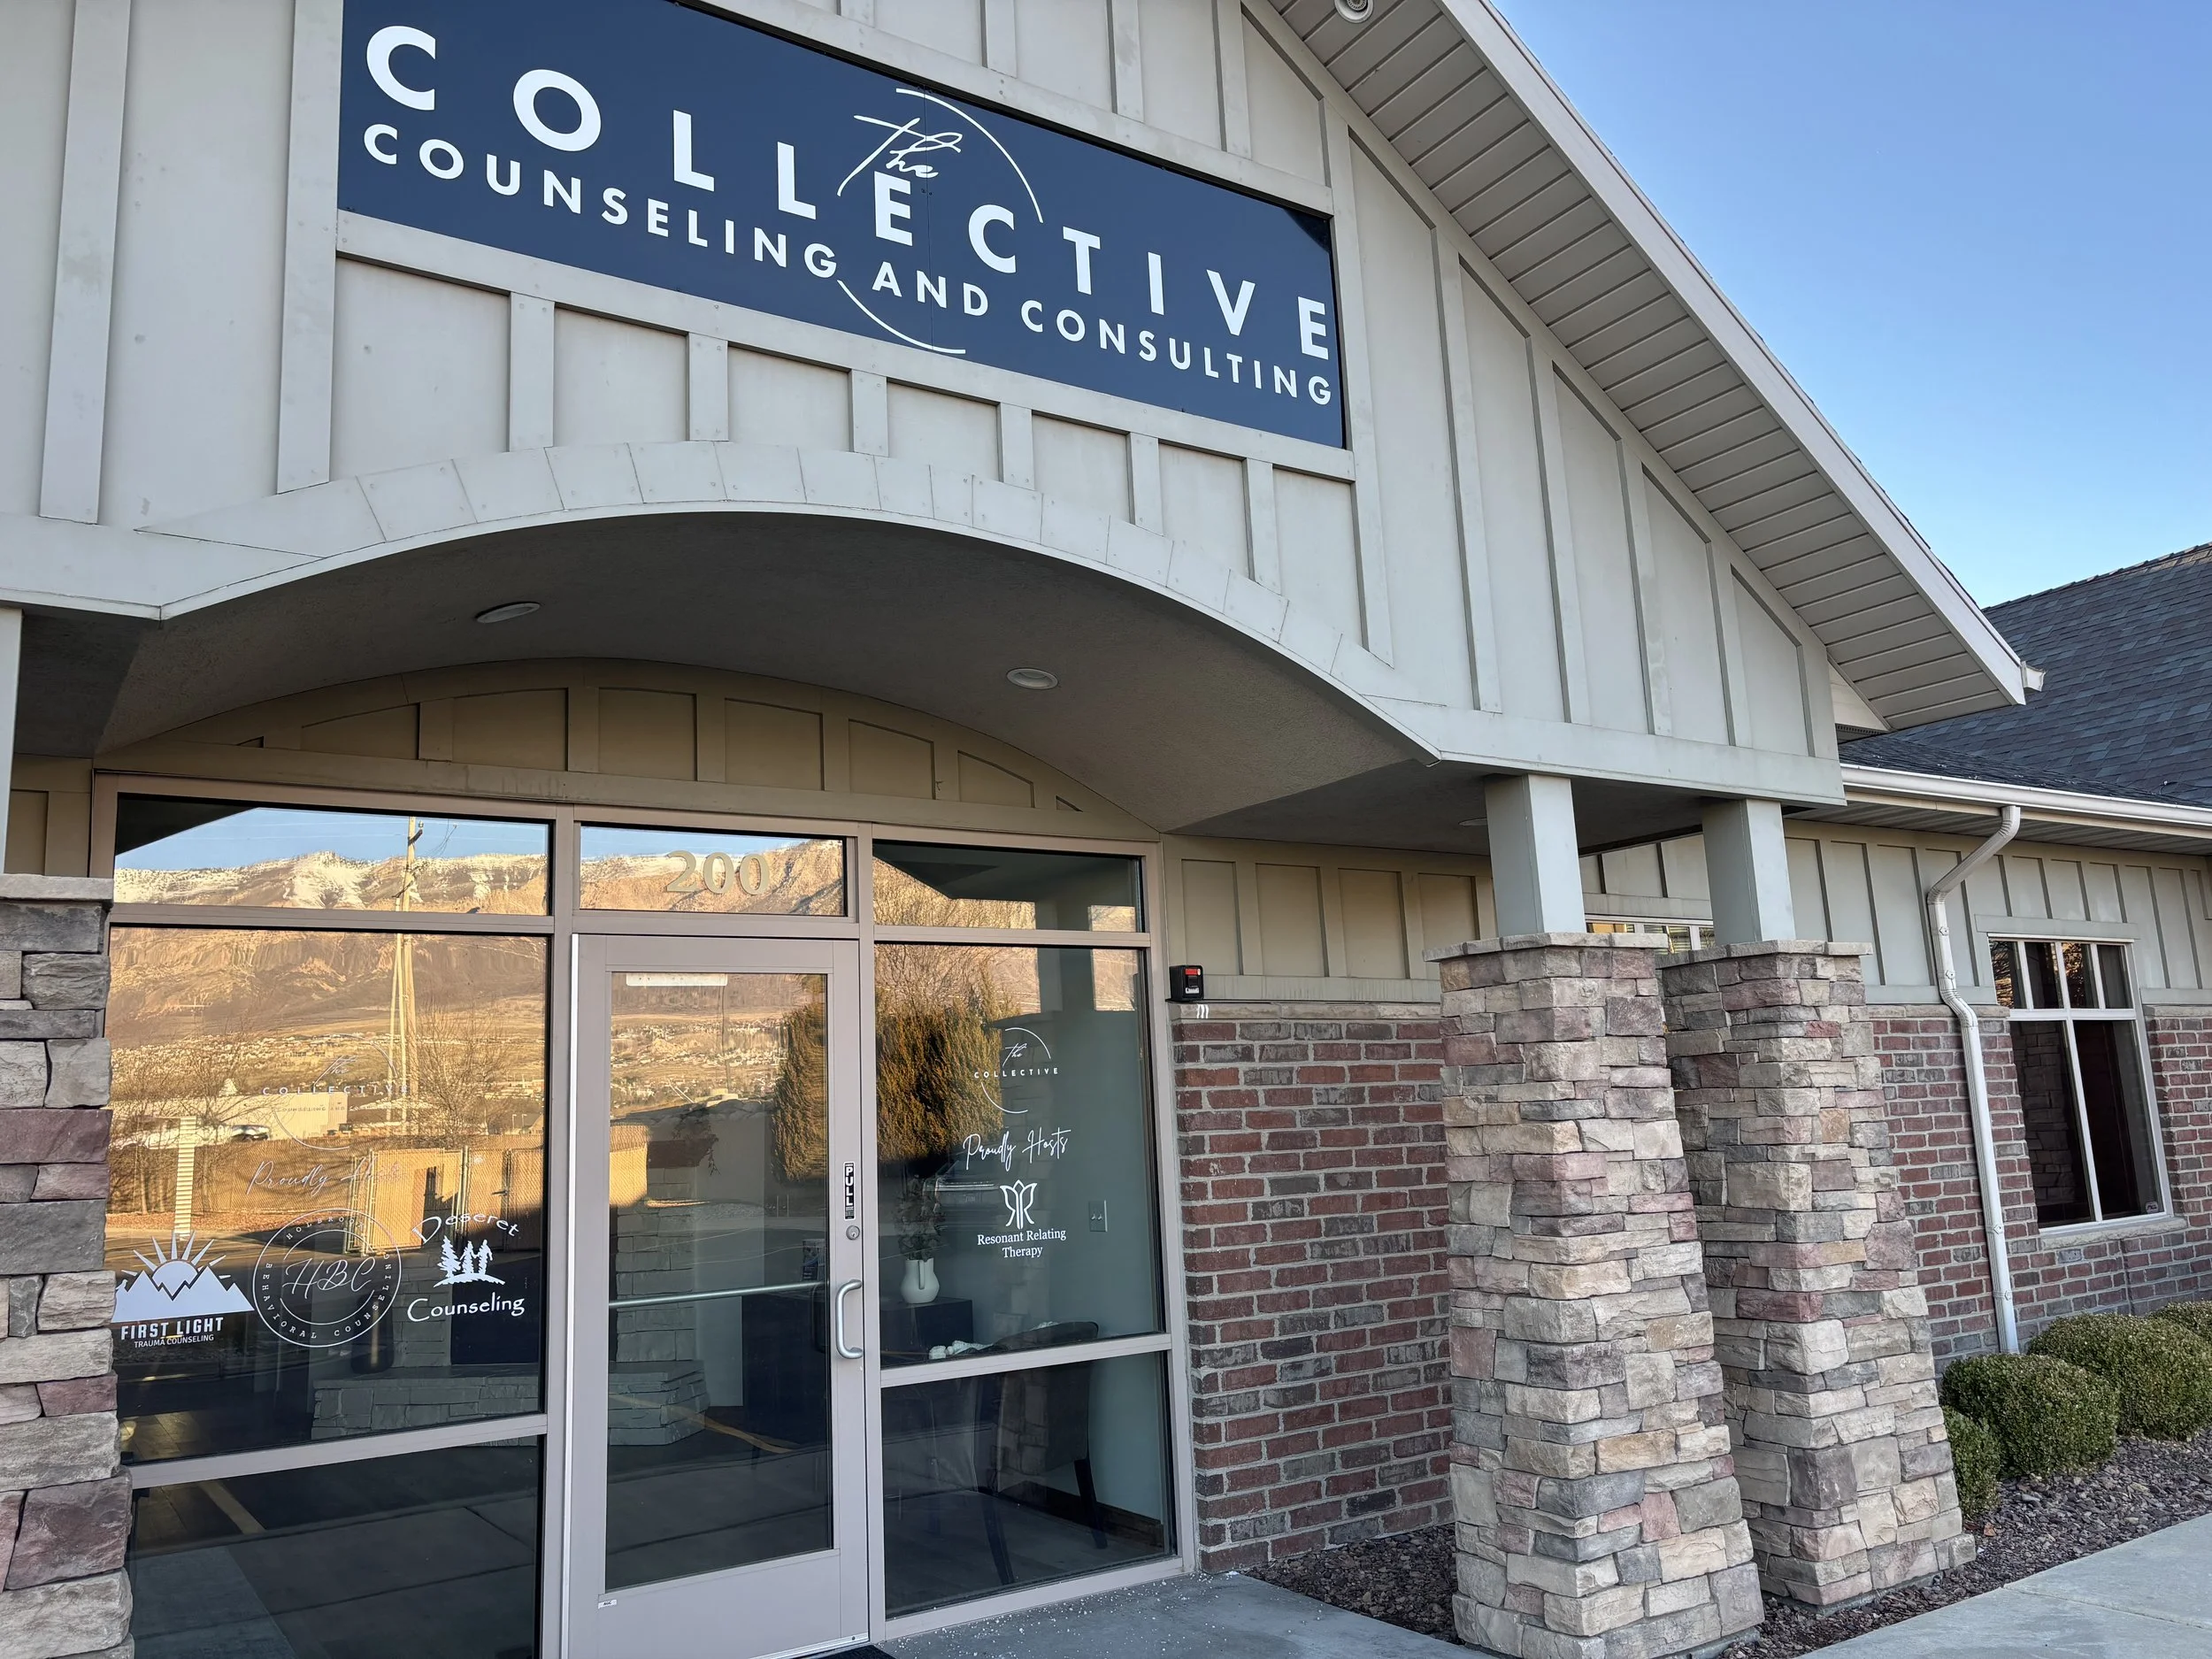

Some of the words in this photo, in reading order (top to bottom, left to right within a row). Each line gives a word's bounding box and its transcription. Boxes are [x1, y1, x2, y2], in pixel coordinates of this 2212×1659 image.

[365, 25, 1329, 360] COLLECTIVE
[363, 123, 838, 279] COUNSELING
[872, 261, 989, 317] AND
[1020, 300, 1332, 405] CONSULTING
[666, 850, 771, 895] 200
[262, 1085, 408, 1095] COLLECTIVE
[973, 1067, 1059, 1079] COLLECTIVE
[963, 1131, 1017, 1171] Proudly
[1022, 1126, 1071, 1164] Hosts
[246, 1160, 332, 1197] Proudly
[845, 1166, 854, 1206] PULL
[286, 1216, 365, 1240] HOLBROOK
[411, 1213, 520, 1245] Deseret
[977, 1233, 1025, 1246] Resonant
[1026, 1227, 1067, 1241] Relating
[1002, 1245, 1043, 1258] Therapy
[281, 1256, 376, 1300] HBC
[334, 1253, 393, 1337] COUNSELING
[261, 1262, 318, 1340] BEHAVIORAL
[407, 1292, 526, 1323] Counseling
[120, 1322, 170, 1340] FIRST
[177, 1317, 224, 1336] LIGHT
[134, 1337, 165, 1348] TRAUMA
[166, 1333, 214, 1345] COUNSELING
